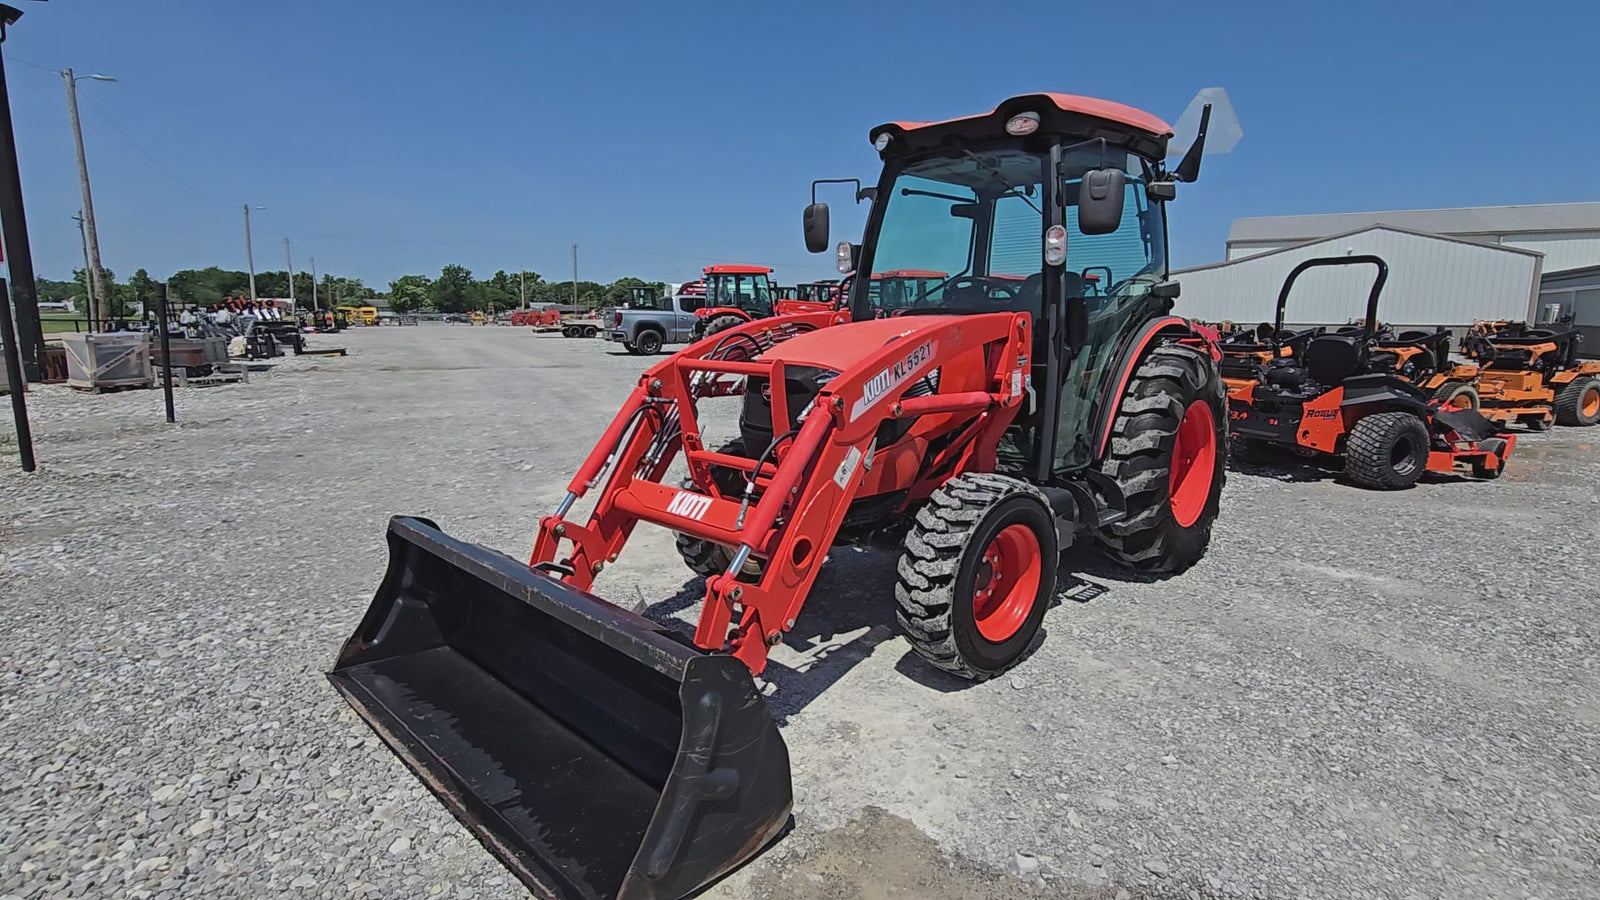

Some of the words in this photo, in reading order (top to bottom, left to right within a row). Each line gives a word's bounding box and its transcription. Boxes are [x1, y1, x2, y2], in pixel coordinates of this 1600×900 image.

[863, 367, 891, 406] KIOTI
[893, 341, 931, 382] KL5521
[666, 490, 713, 521] KIOTI
